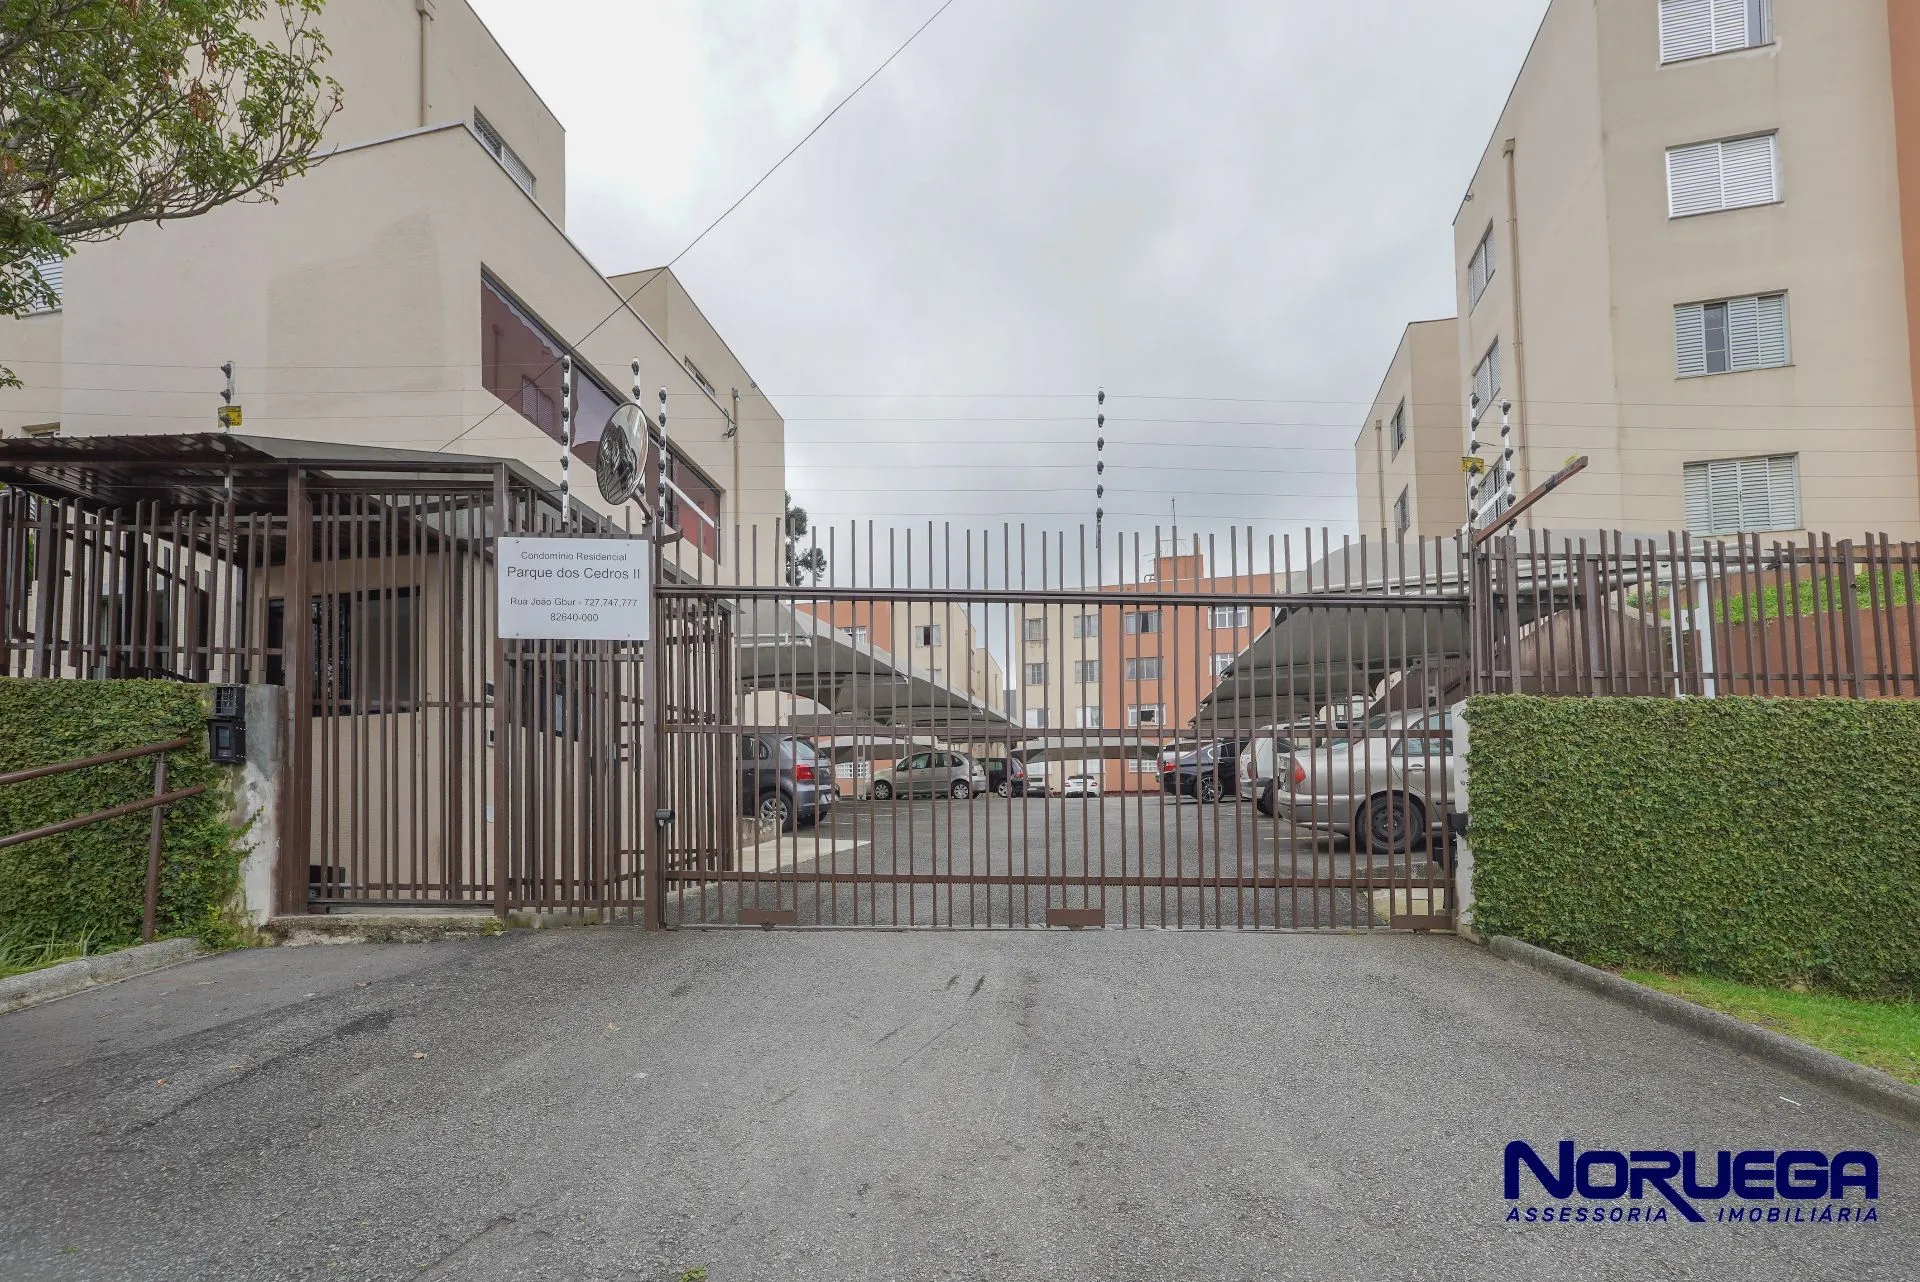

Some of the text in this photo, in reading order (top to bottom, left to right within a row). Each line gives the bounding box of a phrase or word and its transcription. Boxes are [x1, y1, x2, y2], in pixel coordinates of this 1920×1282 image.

[576, 552, 627, 561] Residencial
[507, 566, 641, 580] Parque dos Cedros II
[510, 597, 528, 606] Rua
[530, 597, 552, 606] João
[554, 598, 576, 606] Gbur
[584, 598, 638, 607] 727,747,777
[550, 612, 599, 622] 82640-000
